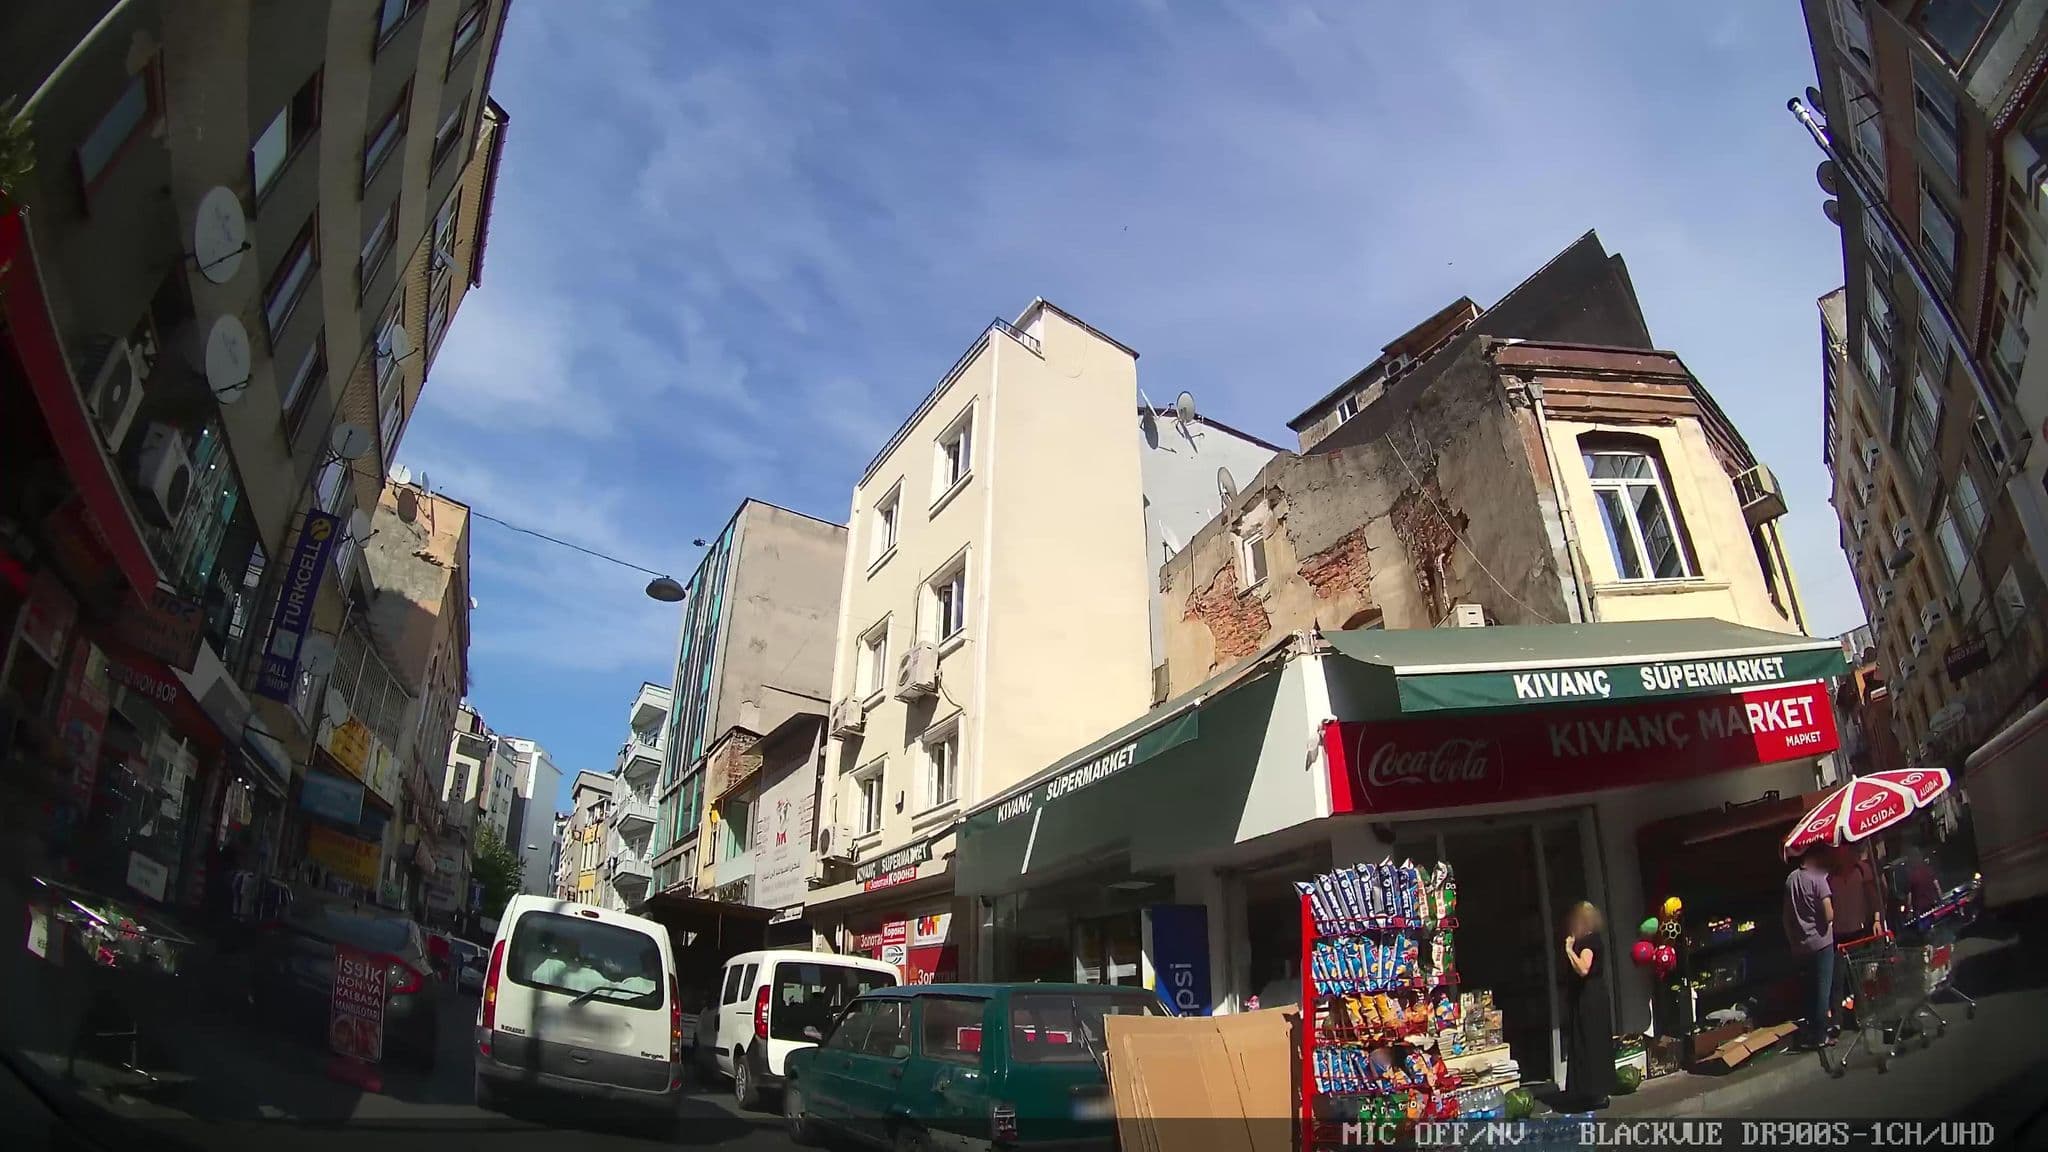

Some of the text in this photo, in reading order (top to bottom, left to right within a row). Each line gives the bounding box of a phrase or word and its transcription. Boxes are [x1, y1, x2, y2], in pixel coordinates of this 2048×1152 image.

[282, 541, 322, 626] TURKCELL
[1513, 656, 1785, 699] KIVANÇ SÜPERMARKET
[1550, 696, 1814, 758] KIVANÇ MARKET
[1368, 738, 1489, 786] Coca-Cola
[997, 792, 1033, 824] KIVANÇ
[1860, 806, 1896, 831] ALGIDA
[1169, 963, 1200, 1016] psi
